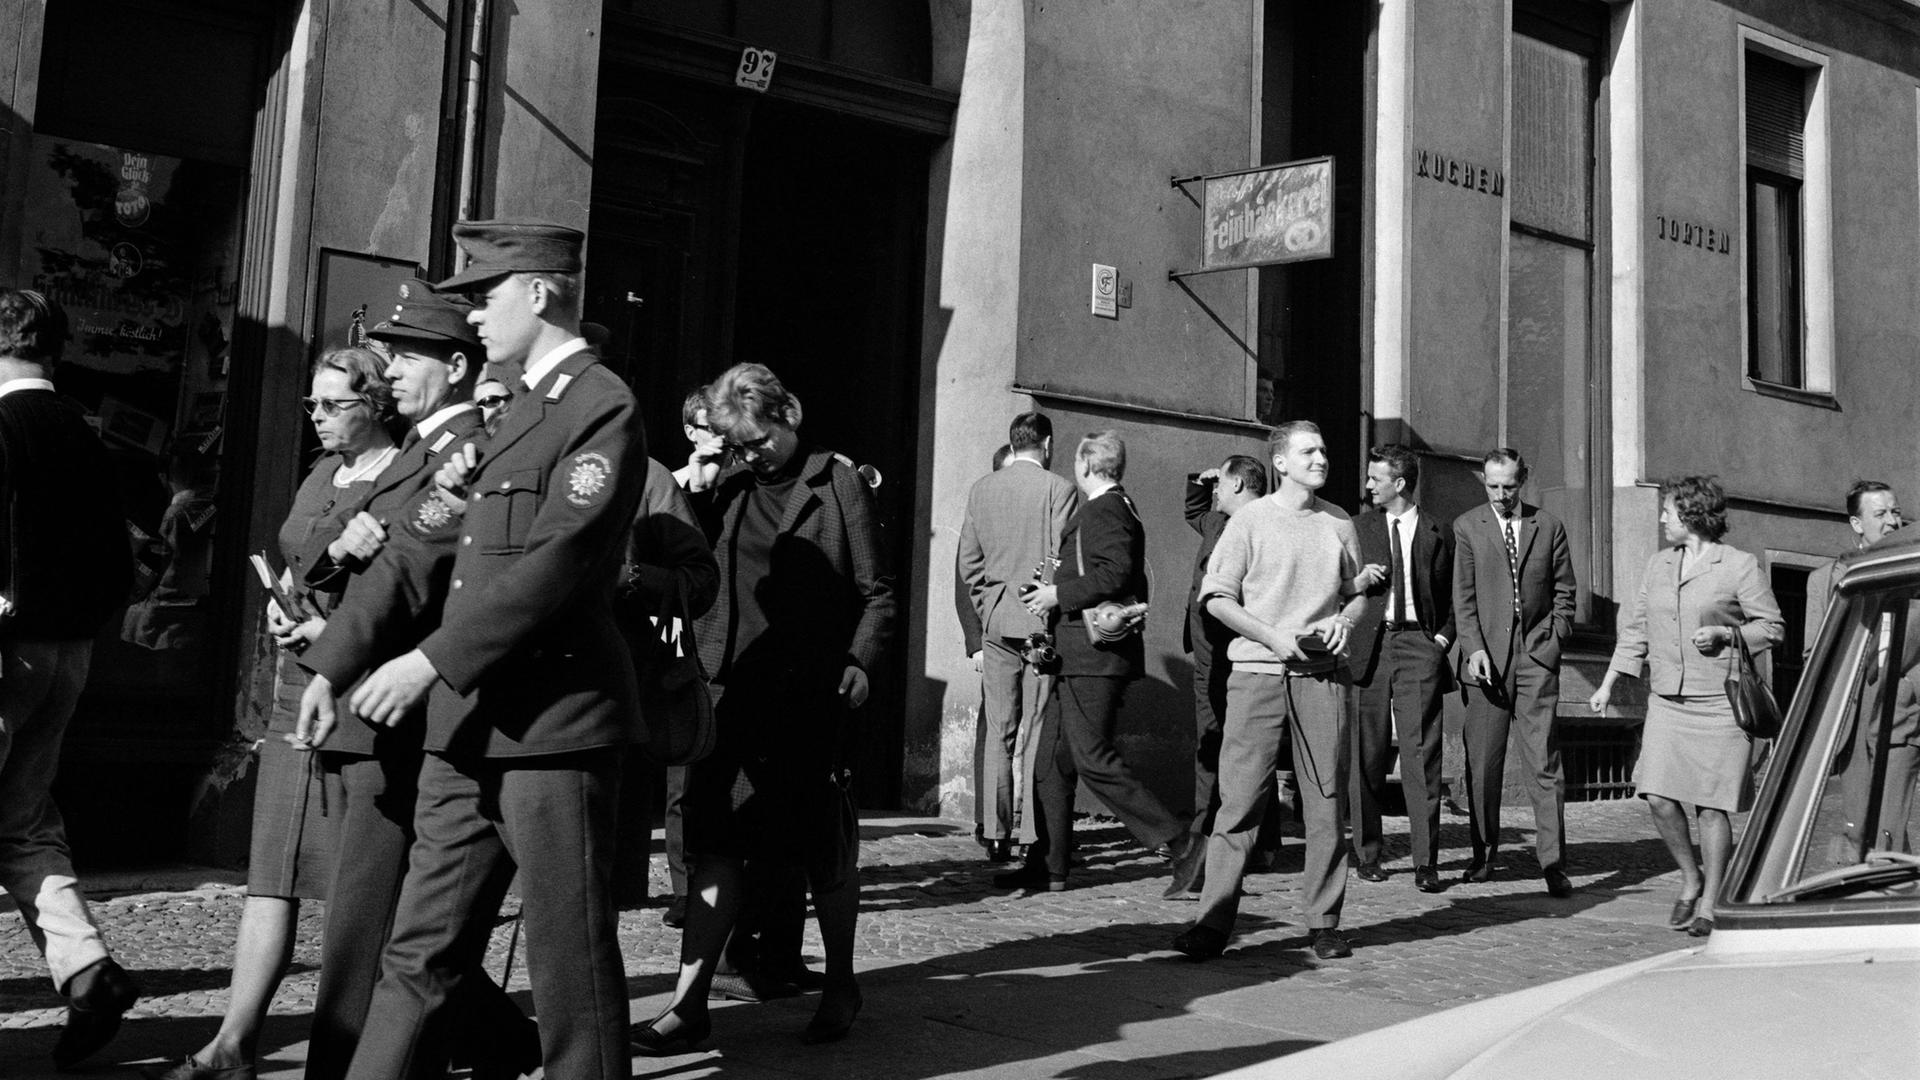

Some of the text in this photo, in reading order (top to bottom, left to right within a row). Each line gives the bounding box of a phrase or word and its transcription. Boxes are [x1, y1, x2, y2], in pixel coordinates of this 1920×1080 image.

[742, 51, 774, 77] 97
[123, 152, 148, 169] Dein
[1416, 150, 1505, 198] KUCHEN
[115, 195, 146, 215] TOTO
[1656, 215, 1730, 255] TORTEN
